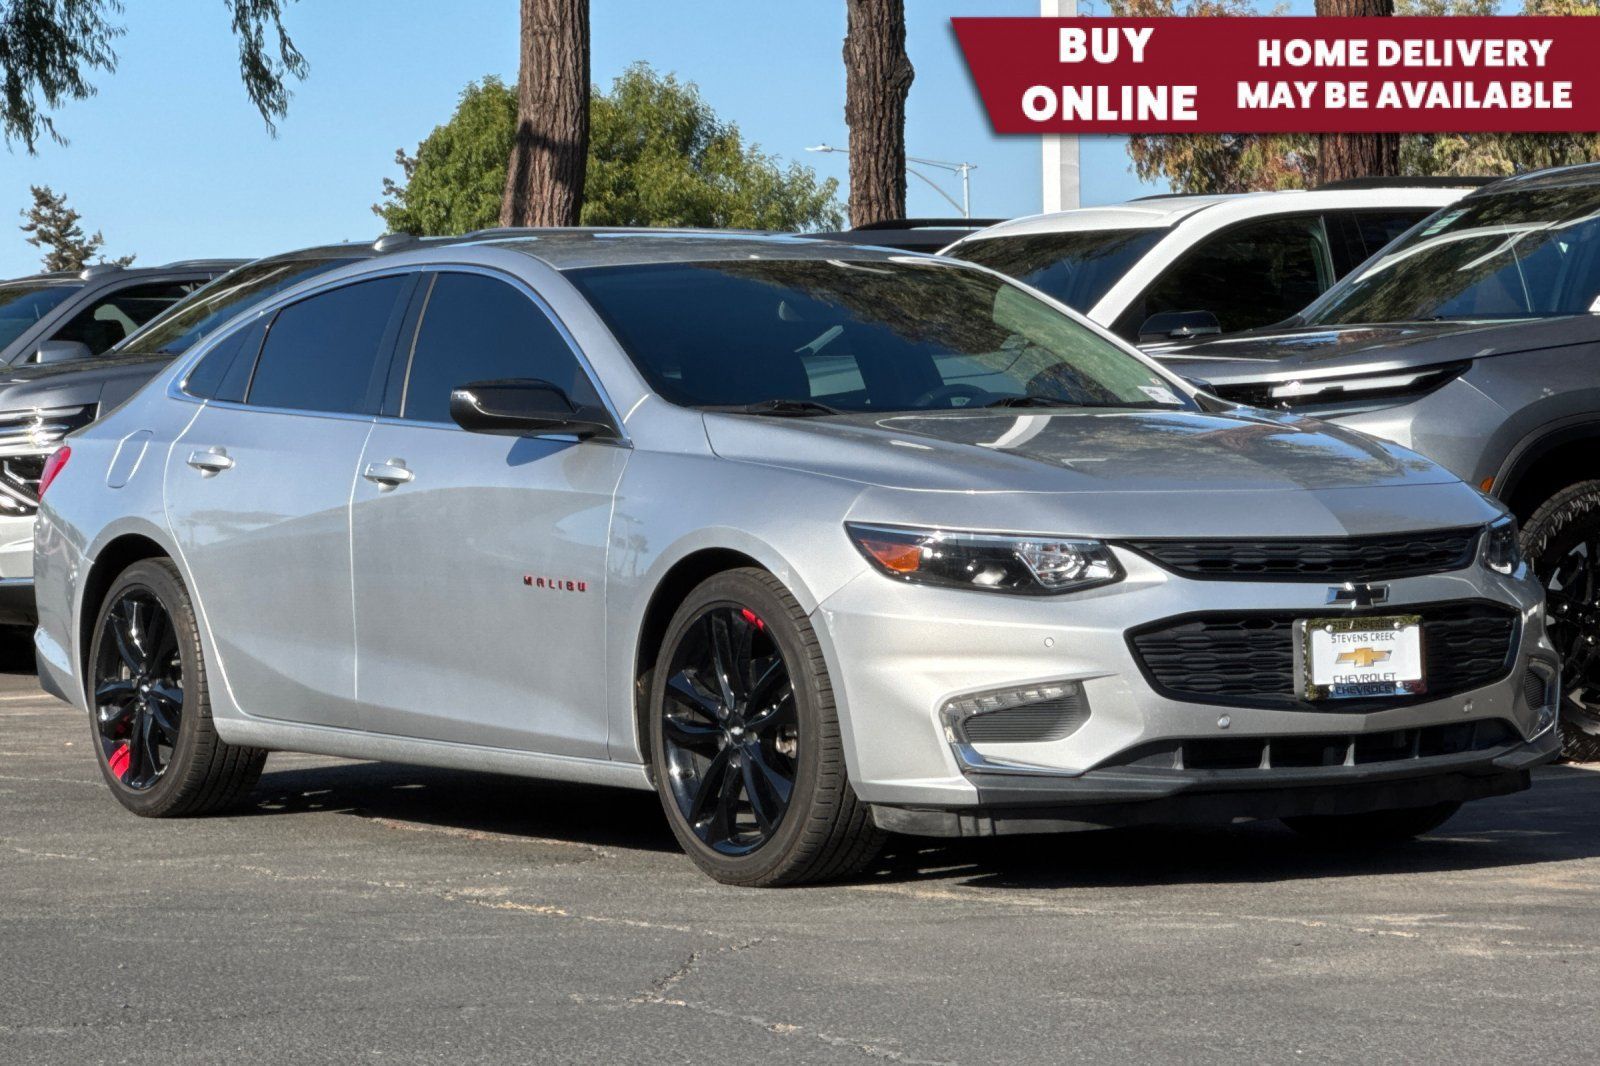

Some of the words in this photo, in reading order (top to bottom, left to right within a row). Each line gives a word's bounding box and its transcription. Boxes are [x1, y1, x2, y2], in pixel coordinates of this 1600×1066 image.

[523, 575, 586, 592] MALIBU
[1331, 633, 1368, 643] STEVENS
[1370, 632, 1395, 641] CREEK
[1333, 672, 1396, 683] CHEVROLET
